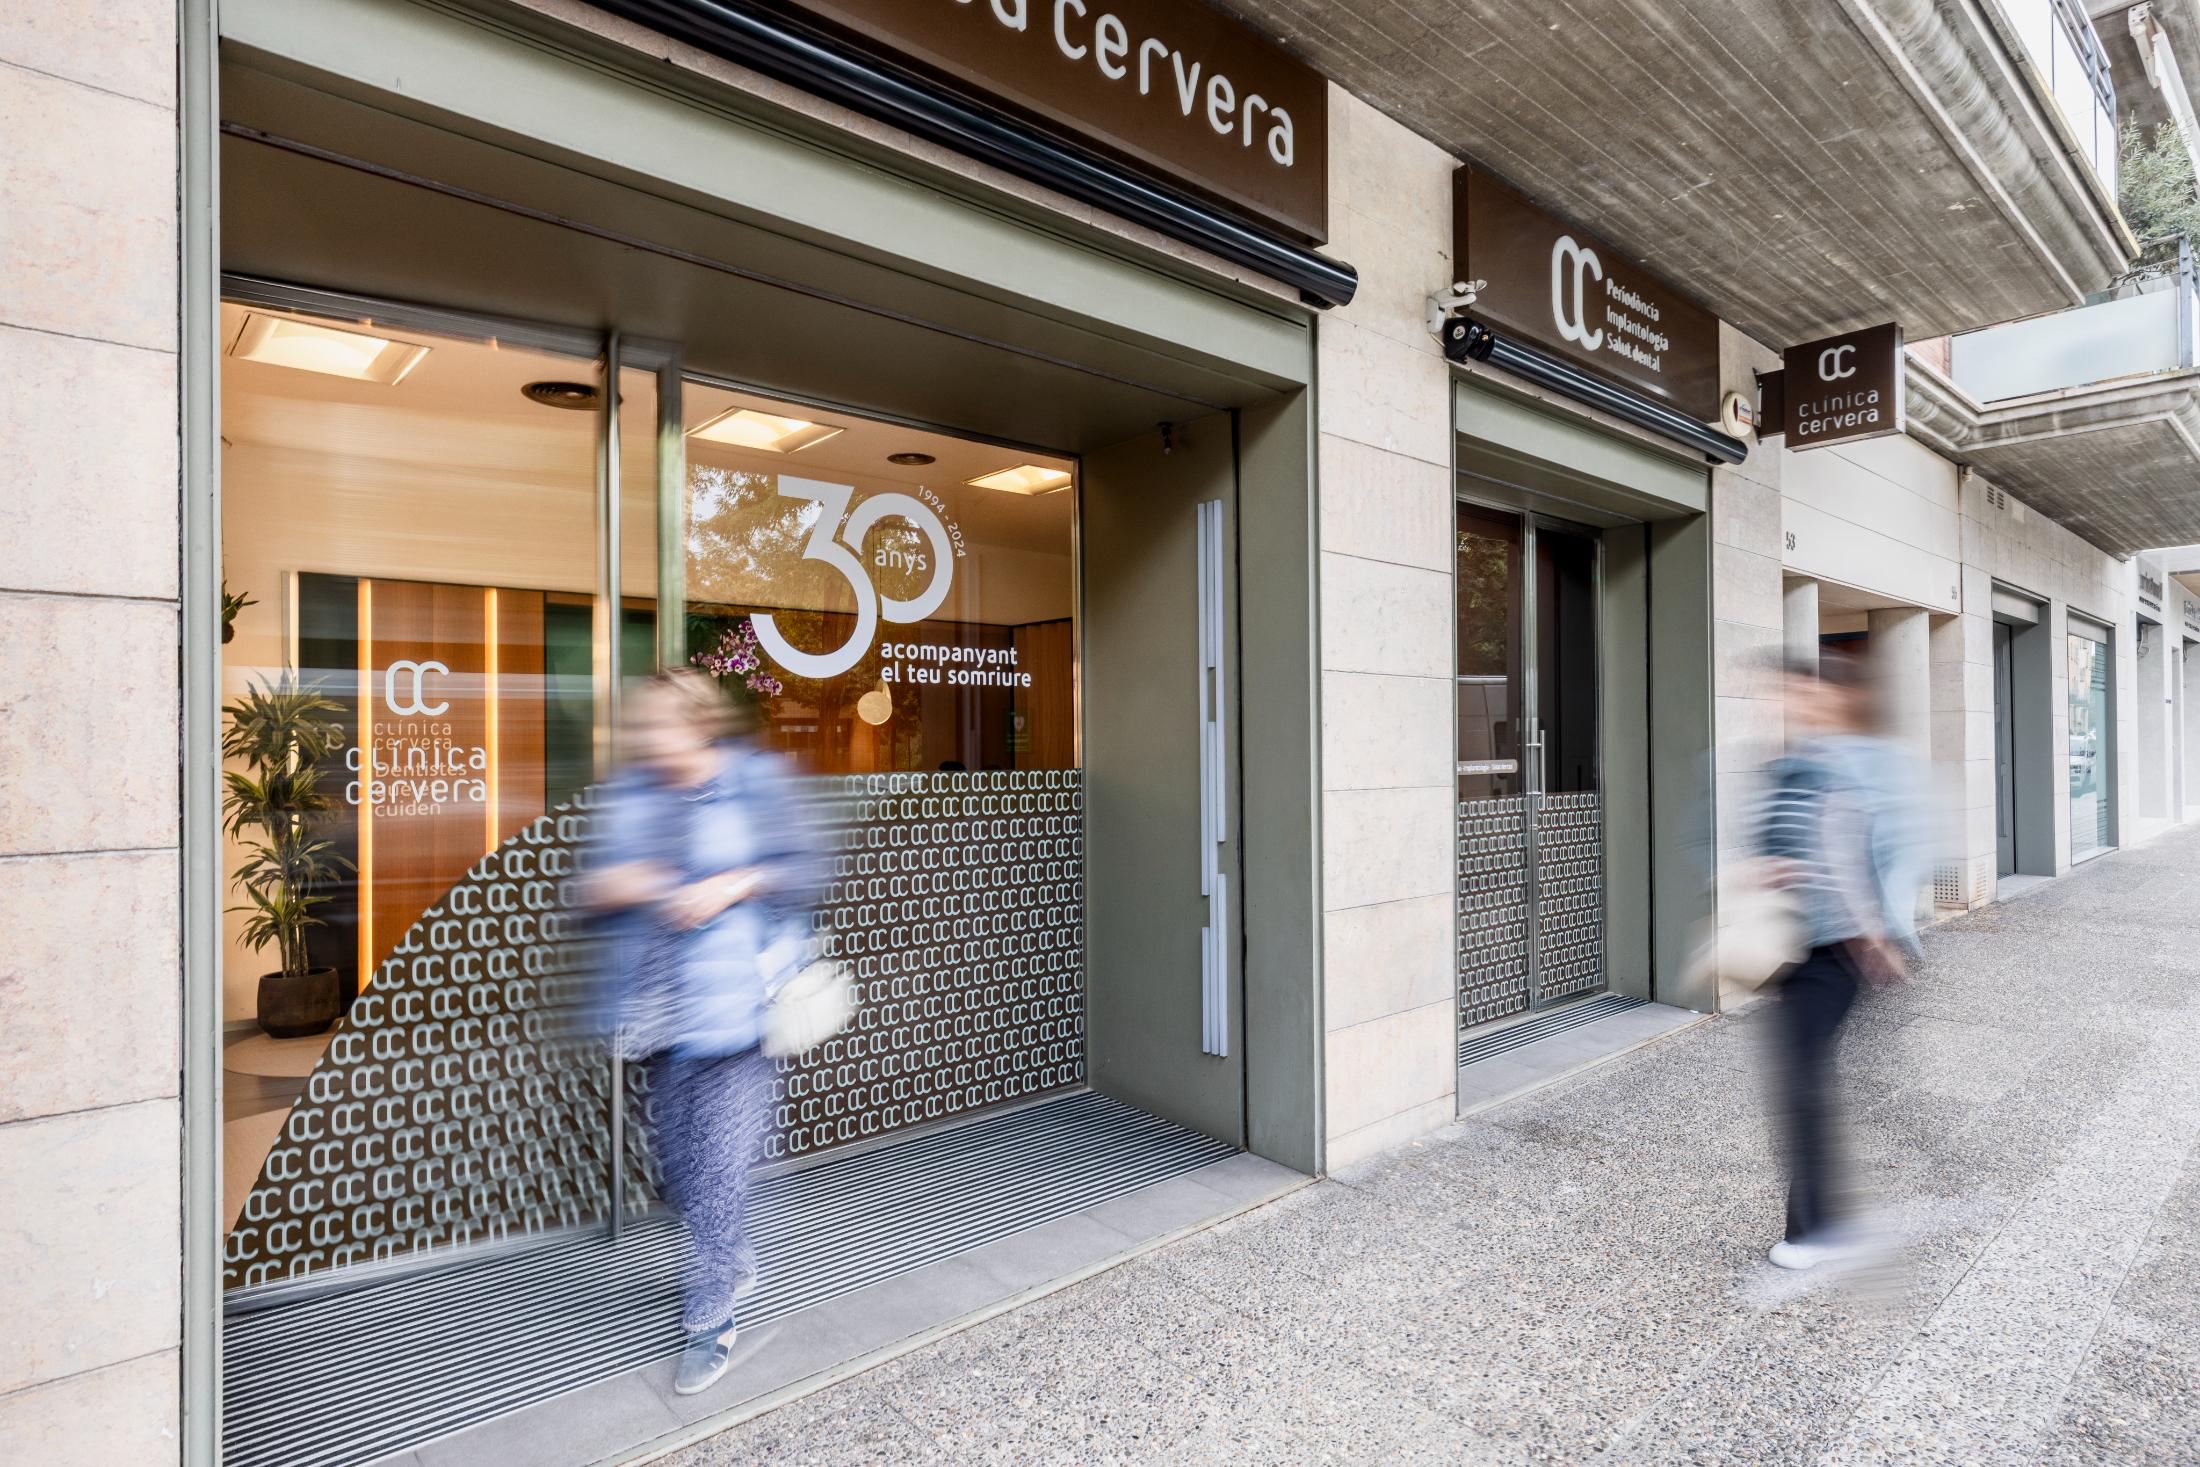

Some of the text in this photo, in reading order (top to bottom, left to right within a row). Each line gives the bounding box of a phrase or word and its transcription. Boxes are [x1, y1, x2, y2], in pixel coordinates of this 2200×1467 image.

[1053, 0, 1294, 167] cervera
[1607, 332, 1661, 372] Salut dental
[1799, 408, 1879, 436] cervera
[917, 485, 946, 513] 1994
[947, 522, 967, 558] 2024
[874, 546, 927, 576] anys
[750, 474, 953, 679] 30
[881, 642, 1018, 668] acompanyant
[881, 661, 1032, 687] el teu somriure
[345, 740, 487, 771] clínica
[345, 778, 487, 806] cervera
[374, 800, 441, 817] cuiden
